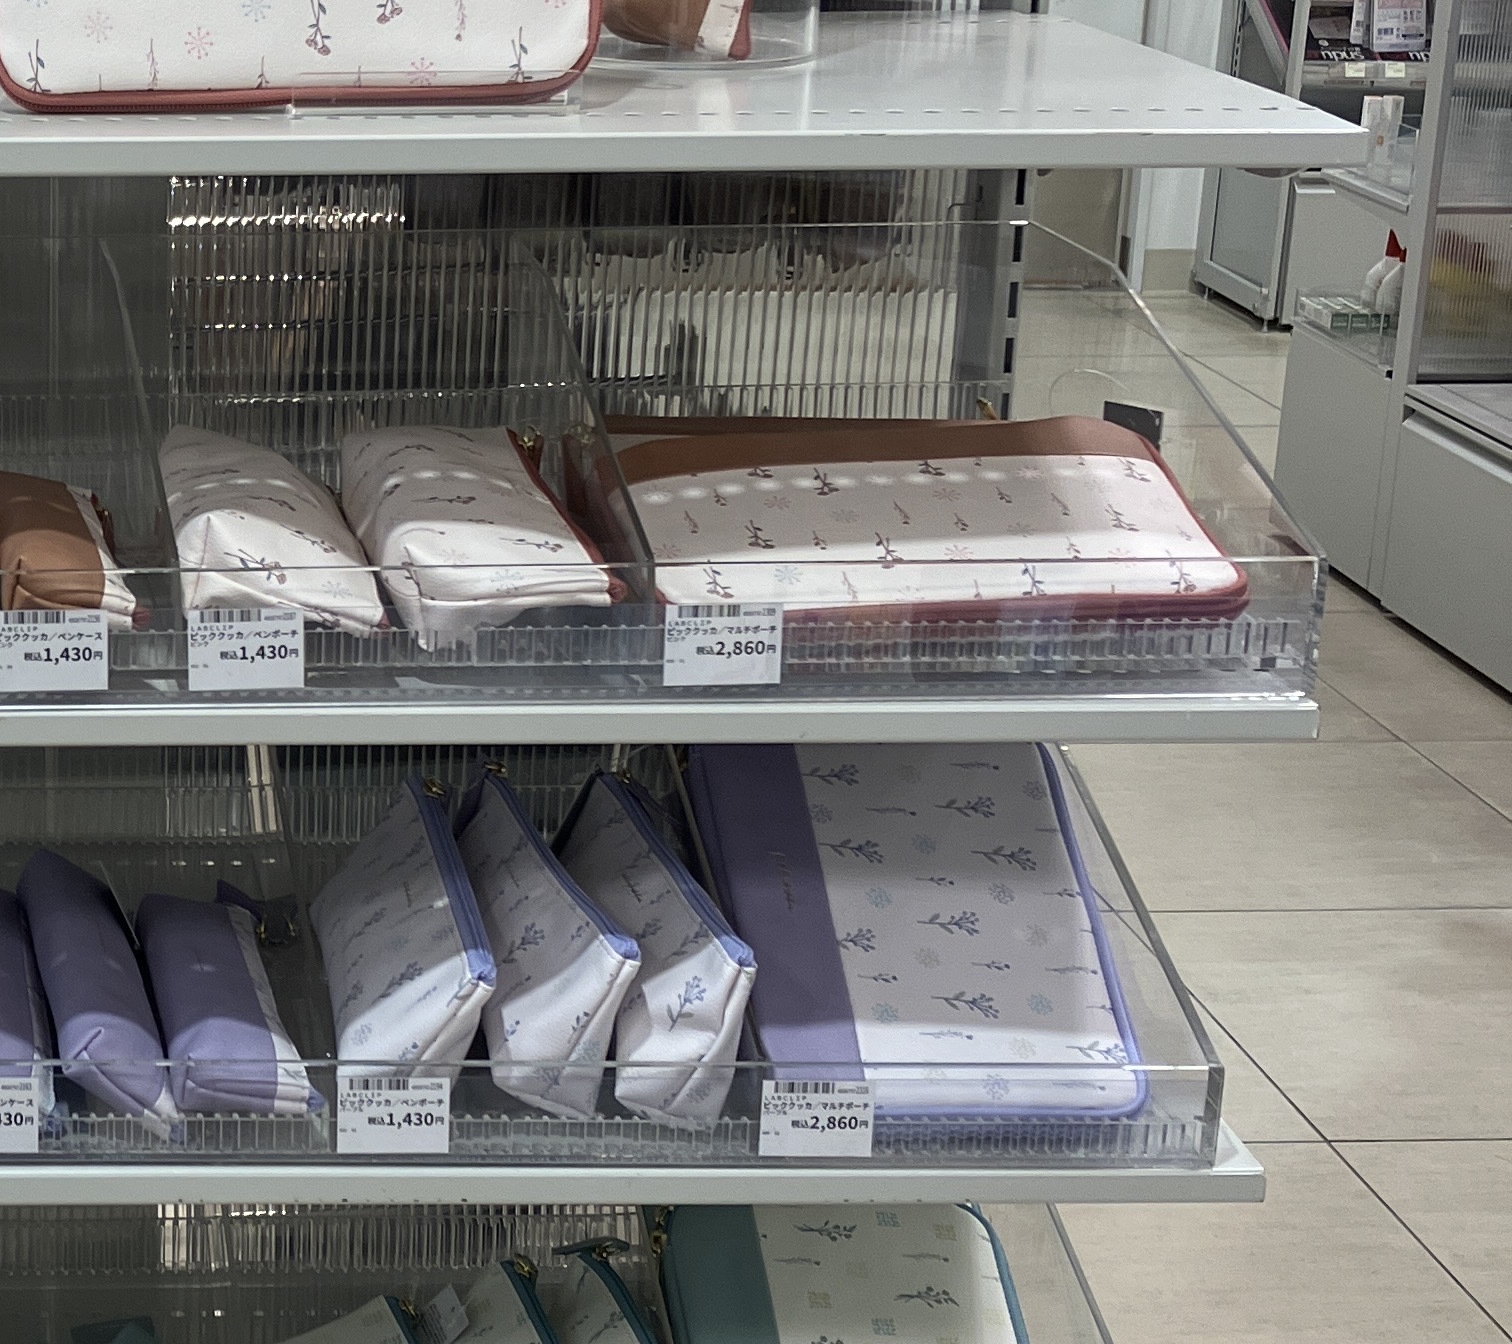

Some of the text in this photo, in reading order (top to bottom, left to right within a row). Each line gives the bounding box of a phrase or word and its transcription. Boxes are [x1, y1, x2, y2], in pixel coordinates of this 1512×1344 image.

[24, 647, 103, 665] 税込1,430円
[220, 646, 298, 663] 税込1,430円
[696, 640, 776, 659] 税込2,860円
[368, 1113, 444, 1129] 税込1,430円
[792, 1116, 868, 1133] 税込2,860円
